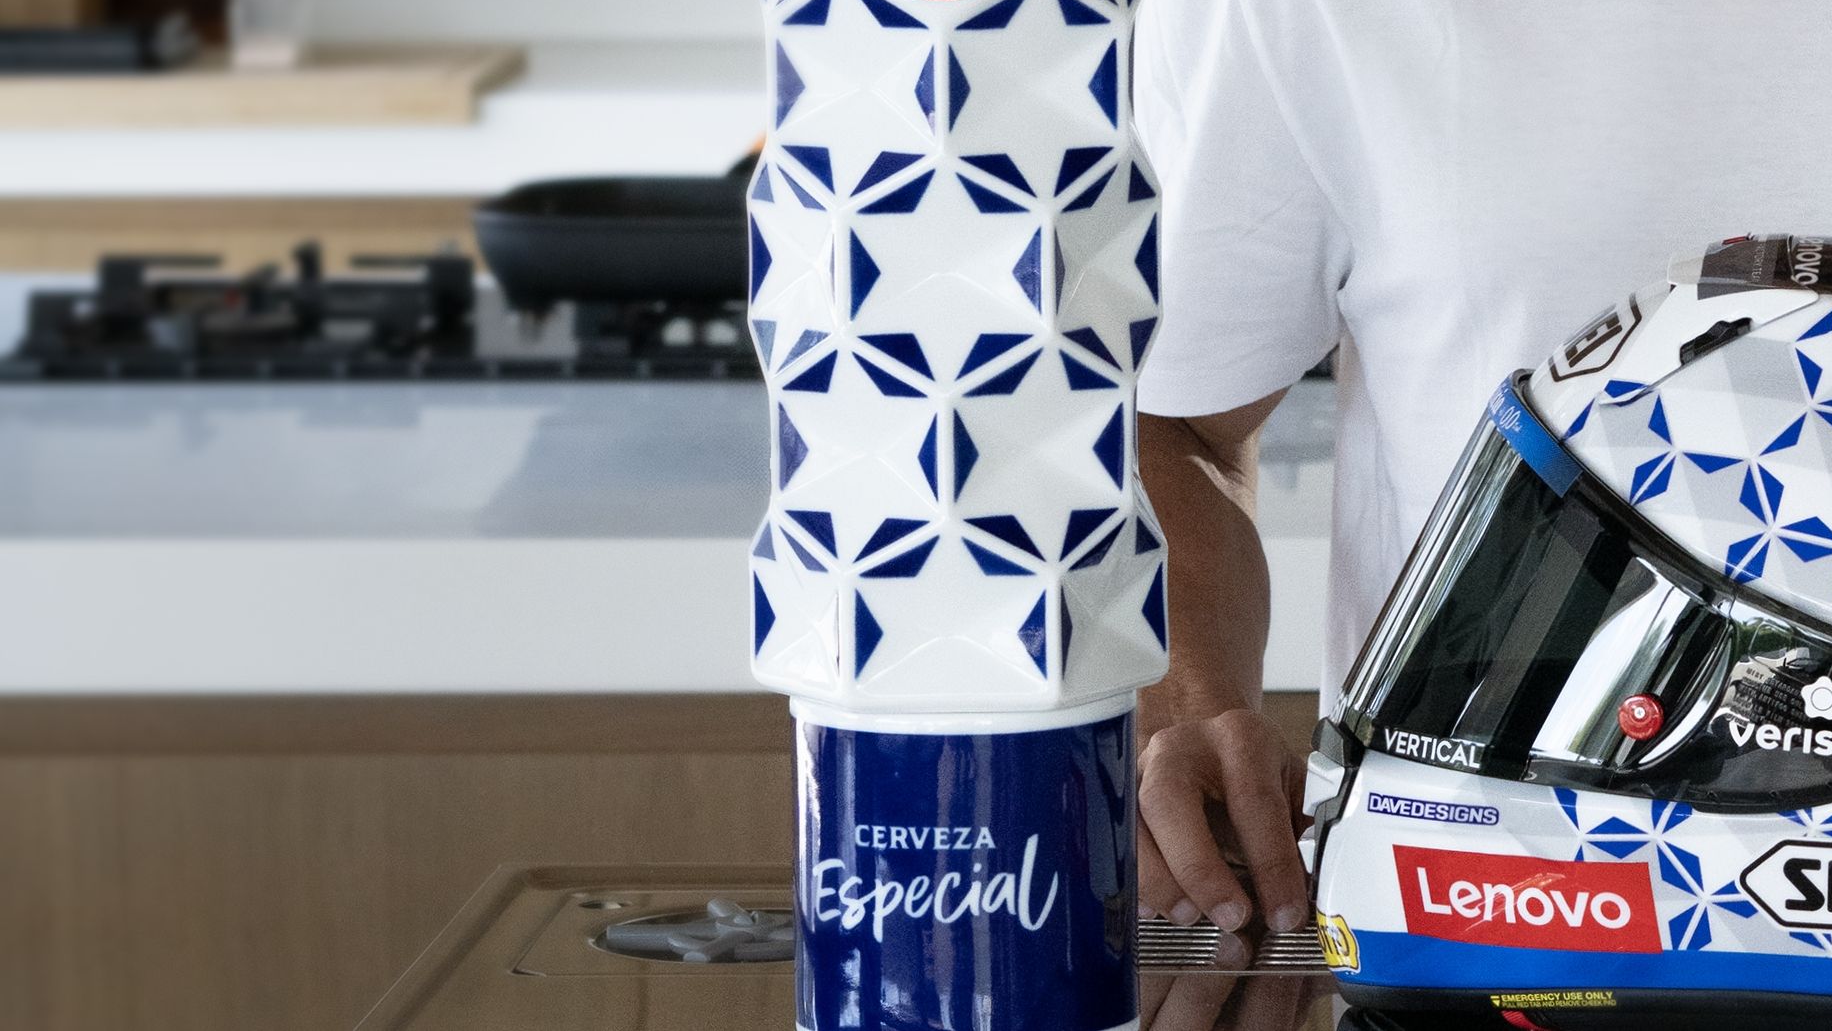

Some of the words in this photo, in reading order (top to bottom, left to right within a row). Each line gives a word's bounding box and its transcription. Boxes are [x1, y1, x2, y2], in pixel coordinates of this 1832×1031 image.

[1384, 728, 1481, 769] VERTICAL
[854, 824, 996, 850] CERVEZA
[812, 833, 1059, 943] Especial
[1417, 866, 1631, 930] Lenovo
[1501, 992, 1560, 1002] EMERGENCY
[1563, 992, 1583, 1001] USE
[1585, 991, 1613, 1001] ONLY
